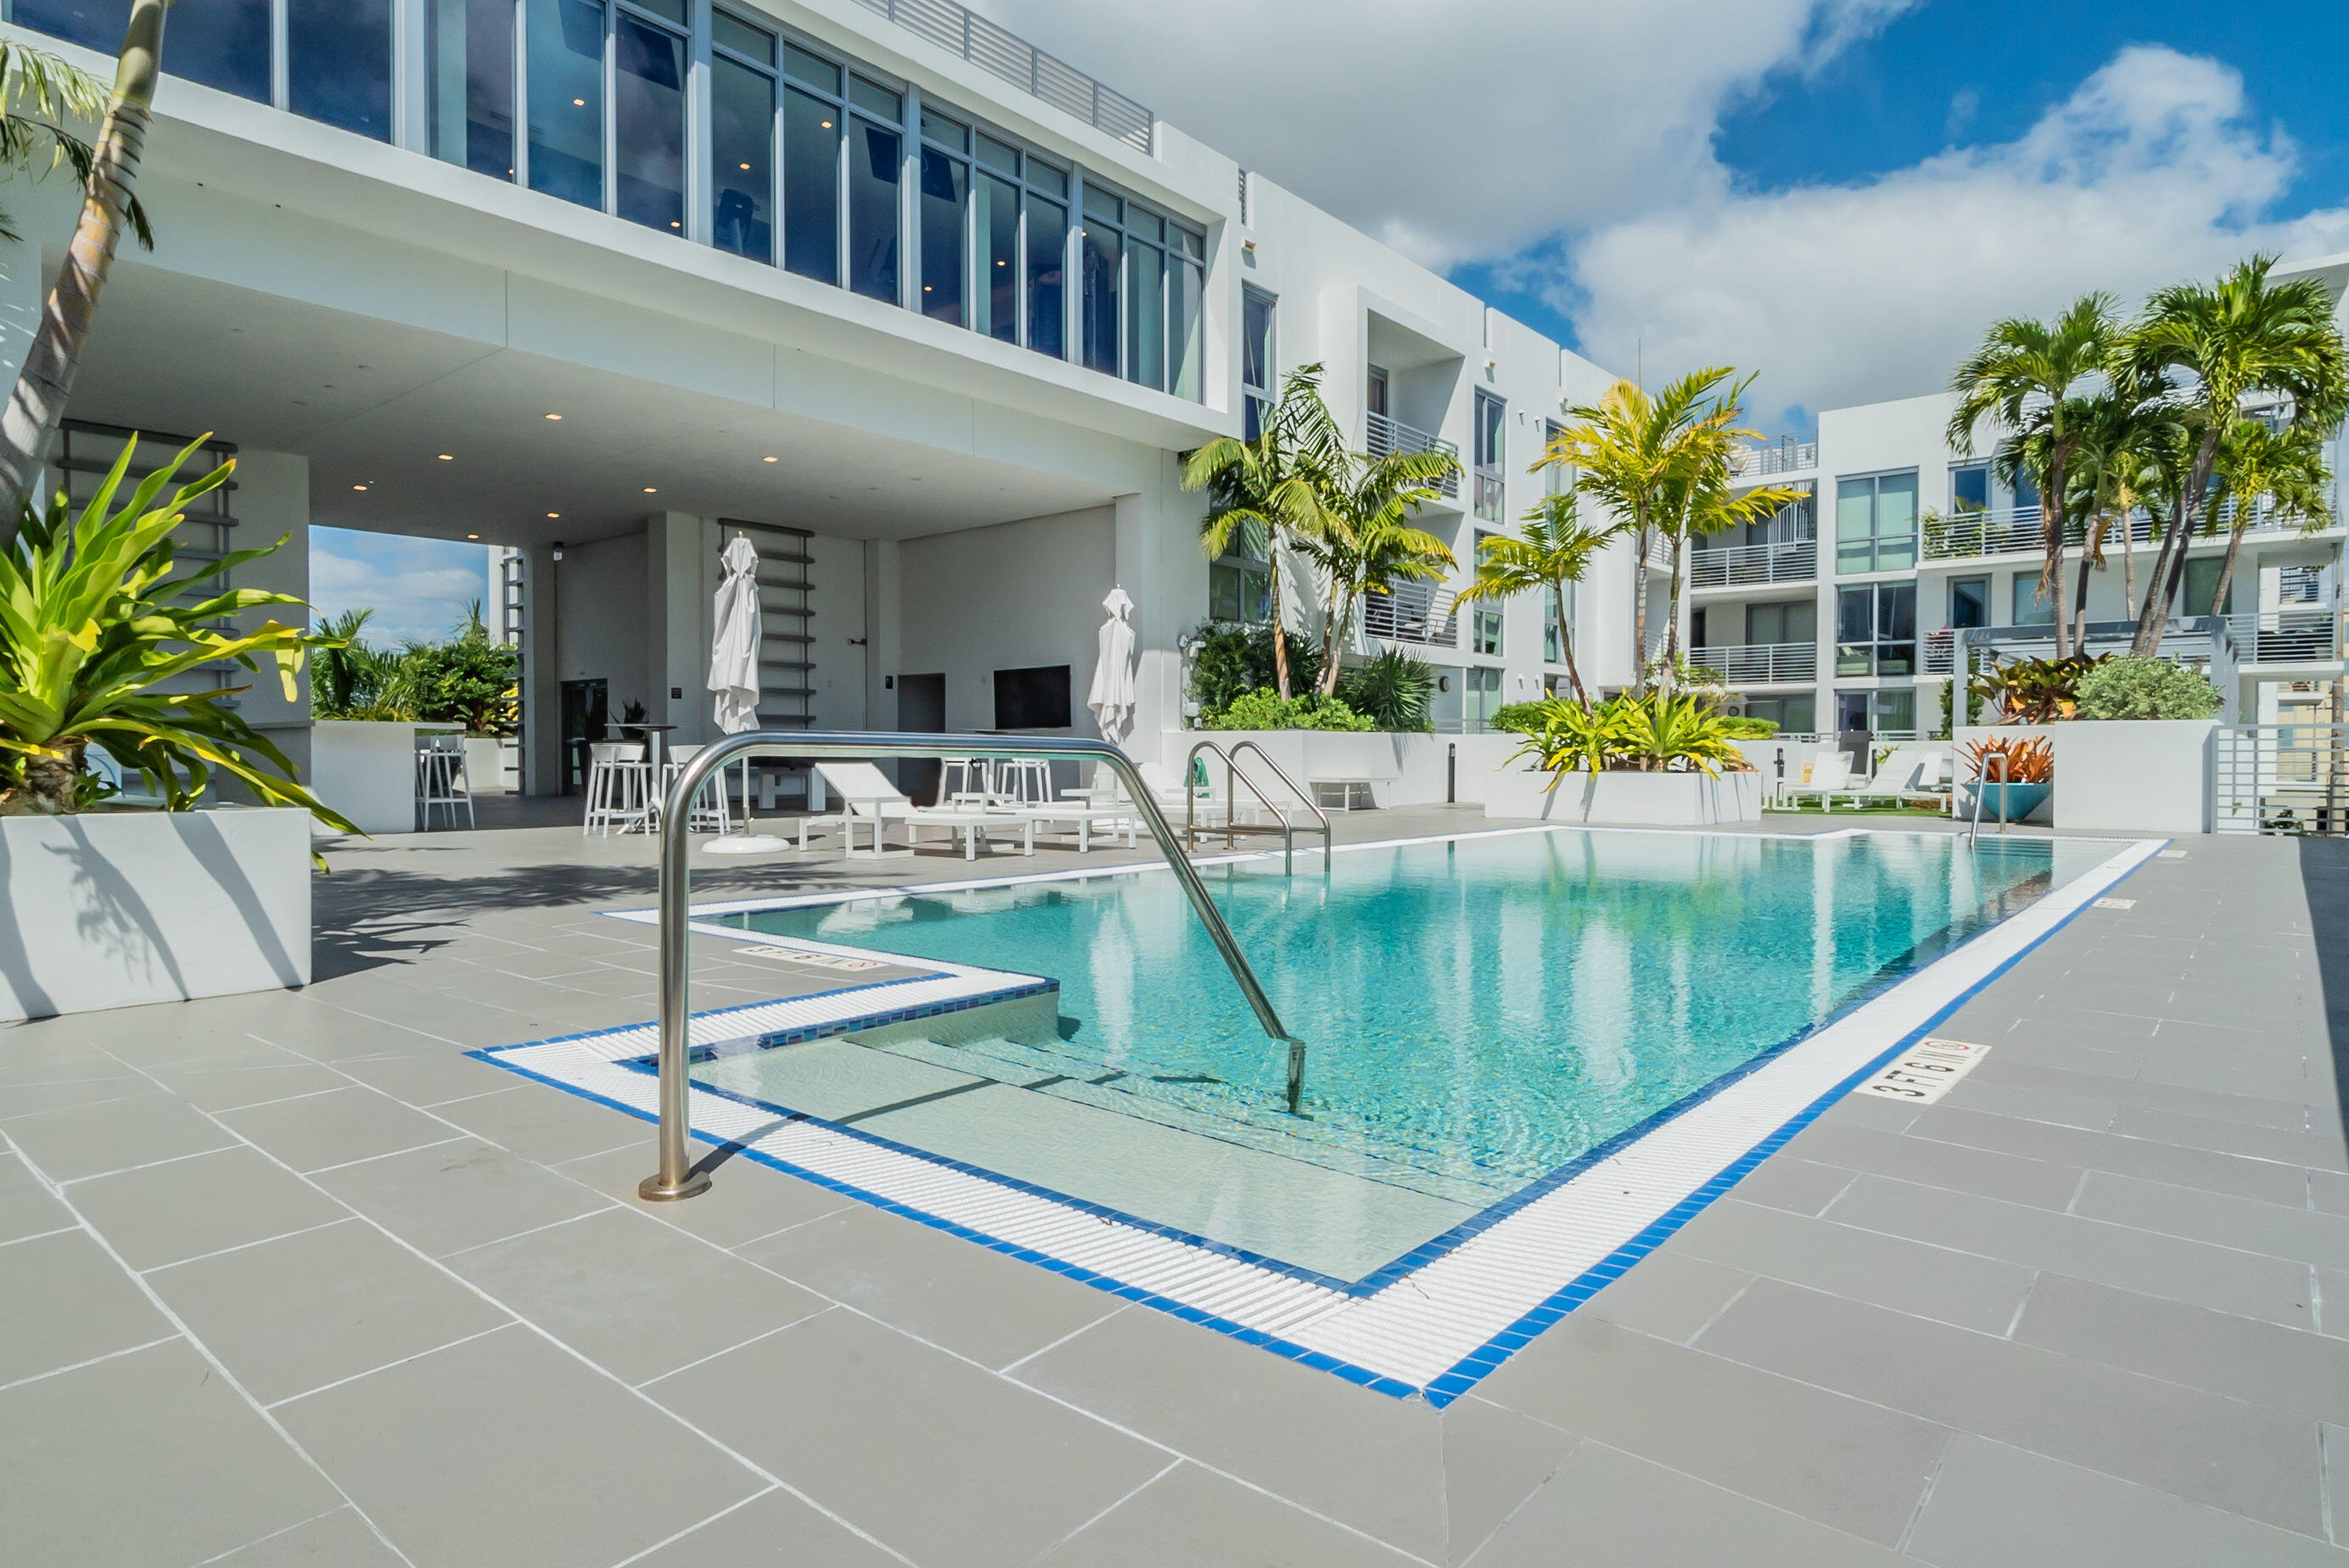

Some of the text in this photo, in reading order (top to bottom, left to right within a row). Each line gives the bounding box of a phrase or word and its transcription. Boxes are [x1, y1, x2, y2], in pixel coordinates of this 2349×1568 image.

[1914, 1050, 1970, 1064] IN
[1903, 1062, 1955, 1072] 6
[1884, 1070, 1943, 1088] FT
[1872, 1085, 1926, 1097] 3
